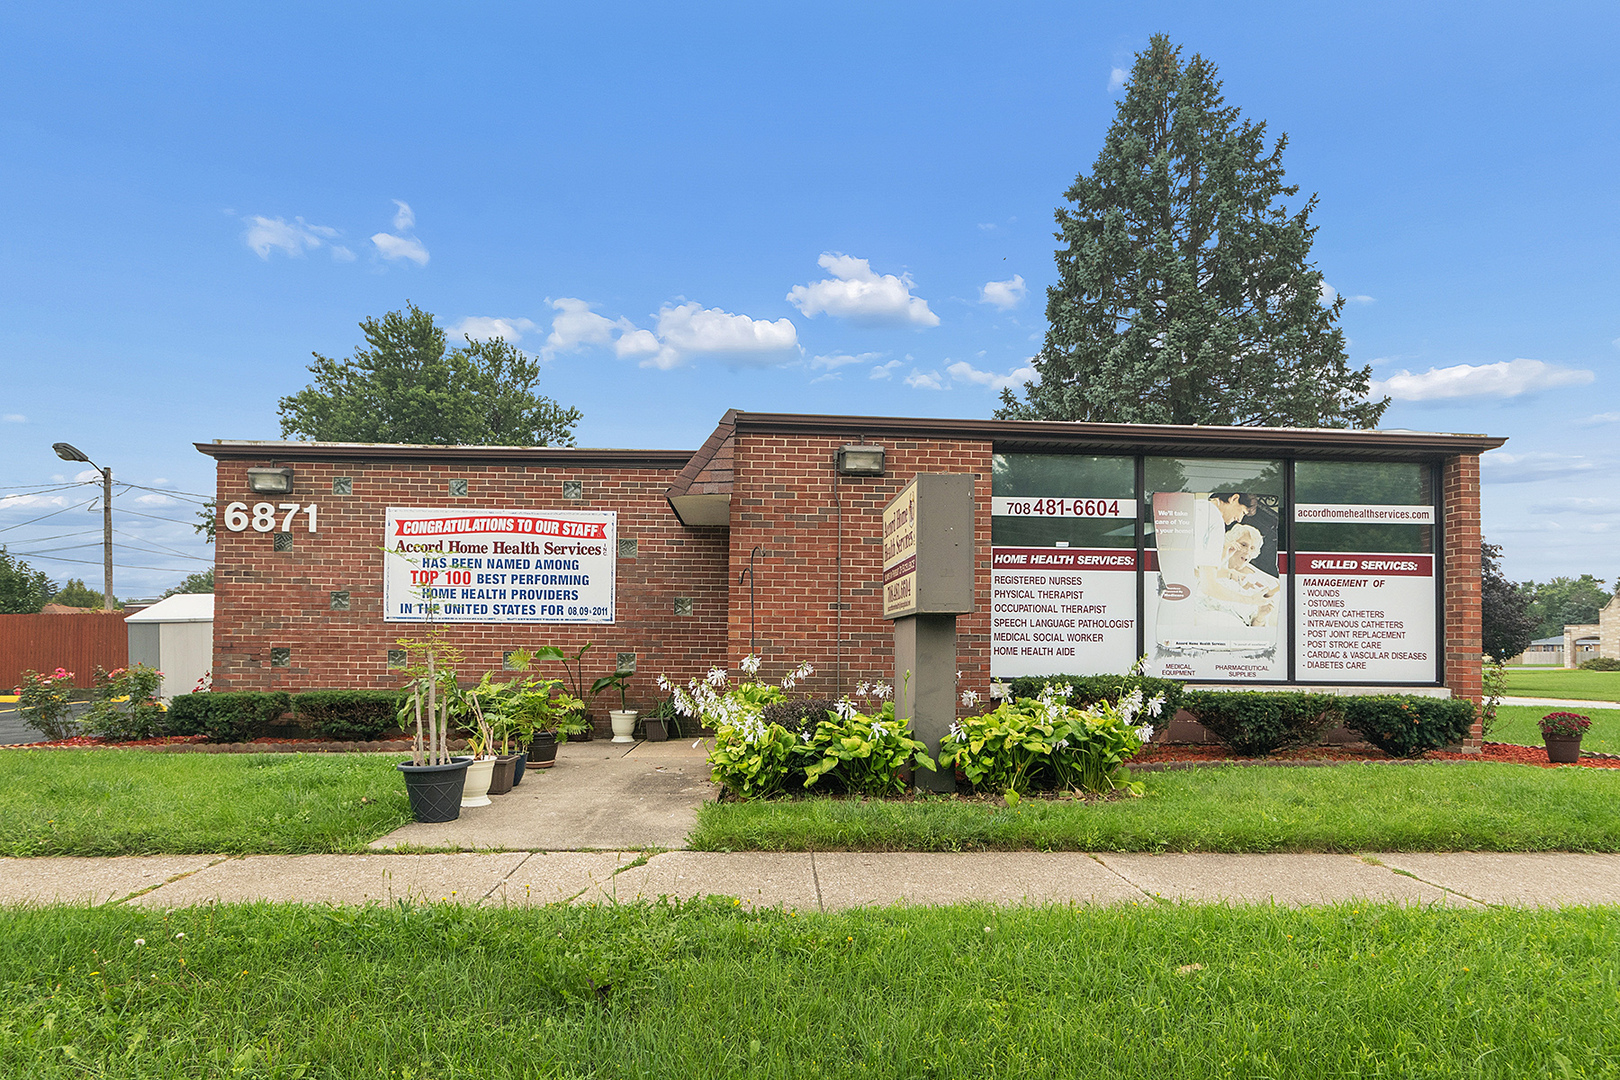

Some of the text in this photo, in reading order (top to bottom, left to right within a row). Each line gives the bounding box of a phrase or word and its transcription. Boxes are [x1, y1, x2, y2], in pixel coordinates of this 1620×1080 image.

[1006, 499, 1120, 516] 708 481-6604
[224, 501, 318, 533] 6871
[1297, 508, 1430, 519] accordhomehealthservices.com
[403, 517, 514, 534] CONGRATULATIONS
[517, 519, 533, 532] TO
[535, 520, 560, 534] OUR
[395, 540, 443, 553] Accord
[448, 540, 488, 554] Home
[493, 541, 540, 555] Health
[544, 542, 602, 556] Services
[422, 557, 579, 570] HAS BEEN NAMED AMONG
[994, 554, 1135, 566] HOME HEALTH SERVICES:
[1310, 559, 1418, 571] SKILLED SERVICES:
[410, 570, 590, 586] TOP 100 BEST PERFORMING
[994, 575, 1083, 586] REGISTERED NURSES
[1302, 578, 1386, 588] MANAGEMENT OF
[422, 588, 579, 600] HOME HEALTH PROVIDERS
[994, 590, 1084, 600] PHYSICAL THERAPIST
[1307, 589, 1340, 598] WOUNDS
[400, 603, 413, 614] IN
[418, 603, 440, 614] THE
[444, 603, 488, 615] UNITED
[493, 604, 536, 615] STATES
[541, 604, 564, 615] FOR
[994, 604, 1107, 614] OCCUPATIONAL THERAPIST
[1307, 599, 1345, 608] OSTOMIES
[1307, 609, 1385, 619] URINARY CATHETERS
[993, 618, 1135, 629] SPEECH LANGUAGE PATHOLOGIST
[1307, 619, 1404, 629] INTRAVENOUS CATHETERS
[993, 632, 1104, 643] MEDICAL SOCIAL WORKER
[1307, 630, 1407, 639] POST JOINT REPLACEMENT
[1307, 640, 1382, 649] POST STROKE CARE
[993, 646, 1076, 656] HOME HEALTH AIDE
[1306, 651, 1428, 661] CARDIAC & VASCULAR DISEASES
[1215, 664, 1270, 672] PHARMACEUTICAL
[1306, 661, 1367, 669] DIABETES CARE
